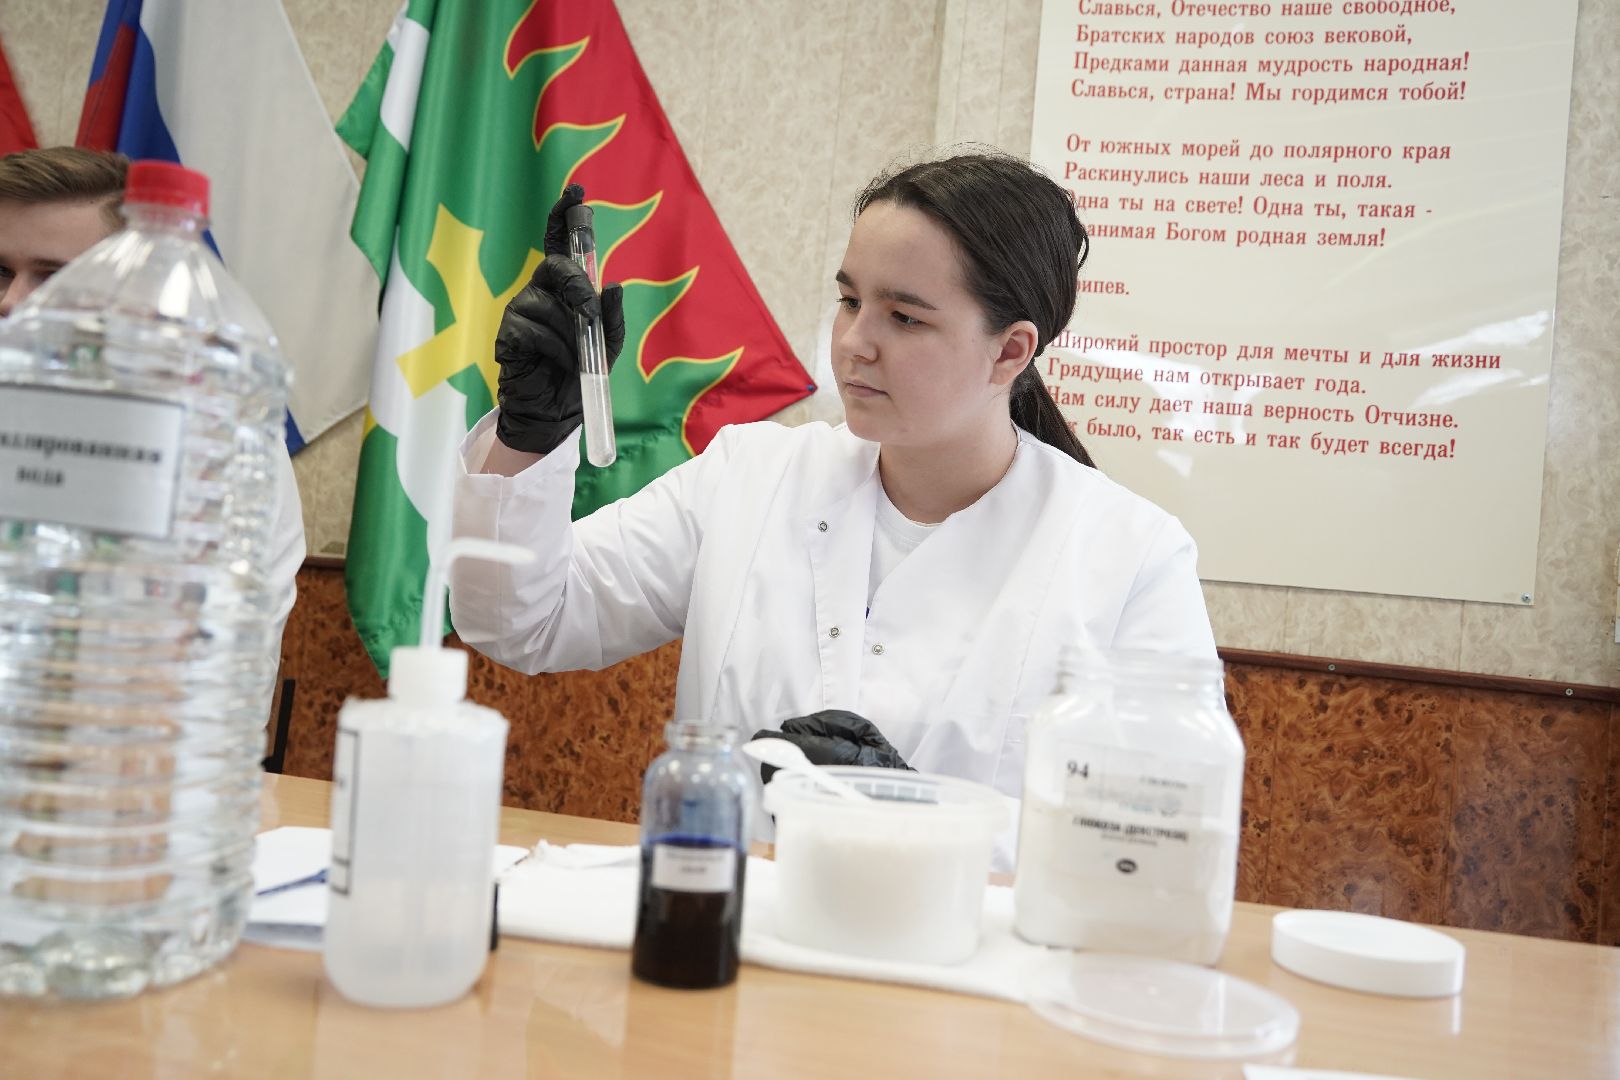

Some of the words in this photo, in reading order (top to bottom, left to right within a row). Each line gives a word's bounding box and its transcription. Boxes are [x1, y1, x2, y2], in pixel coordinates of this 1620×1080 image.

[1078, 0, 1162, 16] Славься,
[1171, 0, 1273, 16] Отечество
[1281, 0, 1332, 16] наше
[1343, 0, 1455, 16] свободное,
[1077, 23, 1165, 48] Братских
[1176, 31, 1255, 48] народов
[1265, 32, 1314, 45] союз
[1324, 26, 1412, 45] вековой,
[1074, 51, 1169, 73] Предками
[1180, 59, 1247, 79] данная
[1258, 58, 1353, 79] мудрость
[1364, 51, 1470, 77] народная!
[1071, 79, 1155, 100] Славься,
[1164, 80, 1236, 104] страна!
[1246, 81, 1281, 101] Мы
[1291, 87, 1388, 106] гордимся
[1400, 80, 1466, 100] тобой!
[1066, 133, 1091, 153] От
[1100, 140, 1170, 159] южных
[1182, 140, 1240, 161] морей
[1250, 144, 1273, 160] до
[1284, 144, 1392, 163] полярного
[1403, 145, 1450, 164] края
[1064, 160, 1189, 186] Раскинулись
[1199, 172, 1250, 186] наши
[1261, 173, 1304, 189] леса
[1315, 175, 1326, 188] и
[1337, 175, 1392, 191] поля.
[1120, 197, 1143, 210] ты
[1153, 198, 1176, 212] на
[1185, 193, 1243, 214] свете!
[1253, 196, 1304, 219] Одна
[1315, 203, 1346, 219] ты,
[1356, 203, 1416, 219] такая
[1086, 224, 1156, 241] анимая
[1167, 221, 1227, 241] Богом
[1235, 229, 1309, 247] родная
[1317, 226, 1387, 247] земля!
[1076, 278, 1130, 296] ипев.
[1051, 330, 1139, 353] Широкий
[1148, 340, 1227, 362] простор
[1236, 345, 1275, 360] для
[1284, 347, 1349, 367] мечты
[1359, 352, 1371, 367] и
[1380, 352, 1420, 368] для
[1432, 353, 1501, 368] жизни
[1047, 356, 1144, 384] Грядущие
[1153, 369, 1190, 384] нам
[1200, 371, 1305, 391] открывает
[1315, 377, 1366, 396] года.
[1047, 384, 1085, 407] Нам
[1093, 394, 1140, 414] силу
[1148, 397, 1193, 416] дает
[1204, 402, 1254, 416] наша
[1264, 404, 1357, 423] верность
[1365, 405, 1459, 429] Отчизне.
[1086, 416, 1143, 440] было,
[1152, 426, 1183, 442] так
[1194, 430, 1235, 448] есть
[1246, 432, 1256, 447] и
[1266, 433, 1301, 448] так
[1310, 431, 1368, 456] будет
[1380, 438, 1456, 462] всегда!
[1067, 760, 1090, 779] 94
